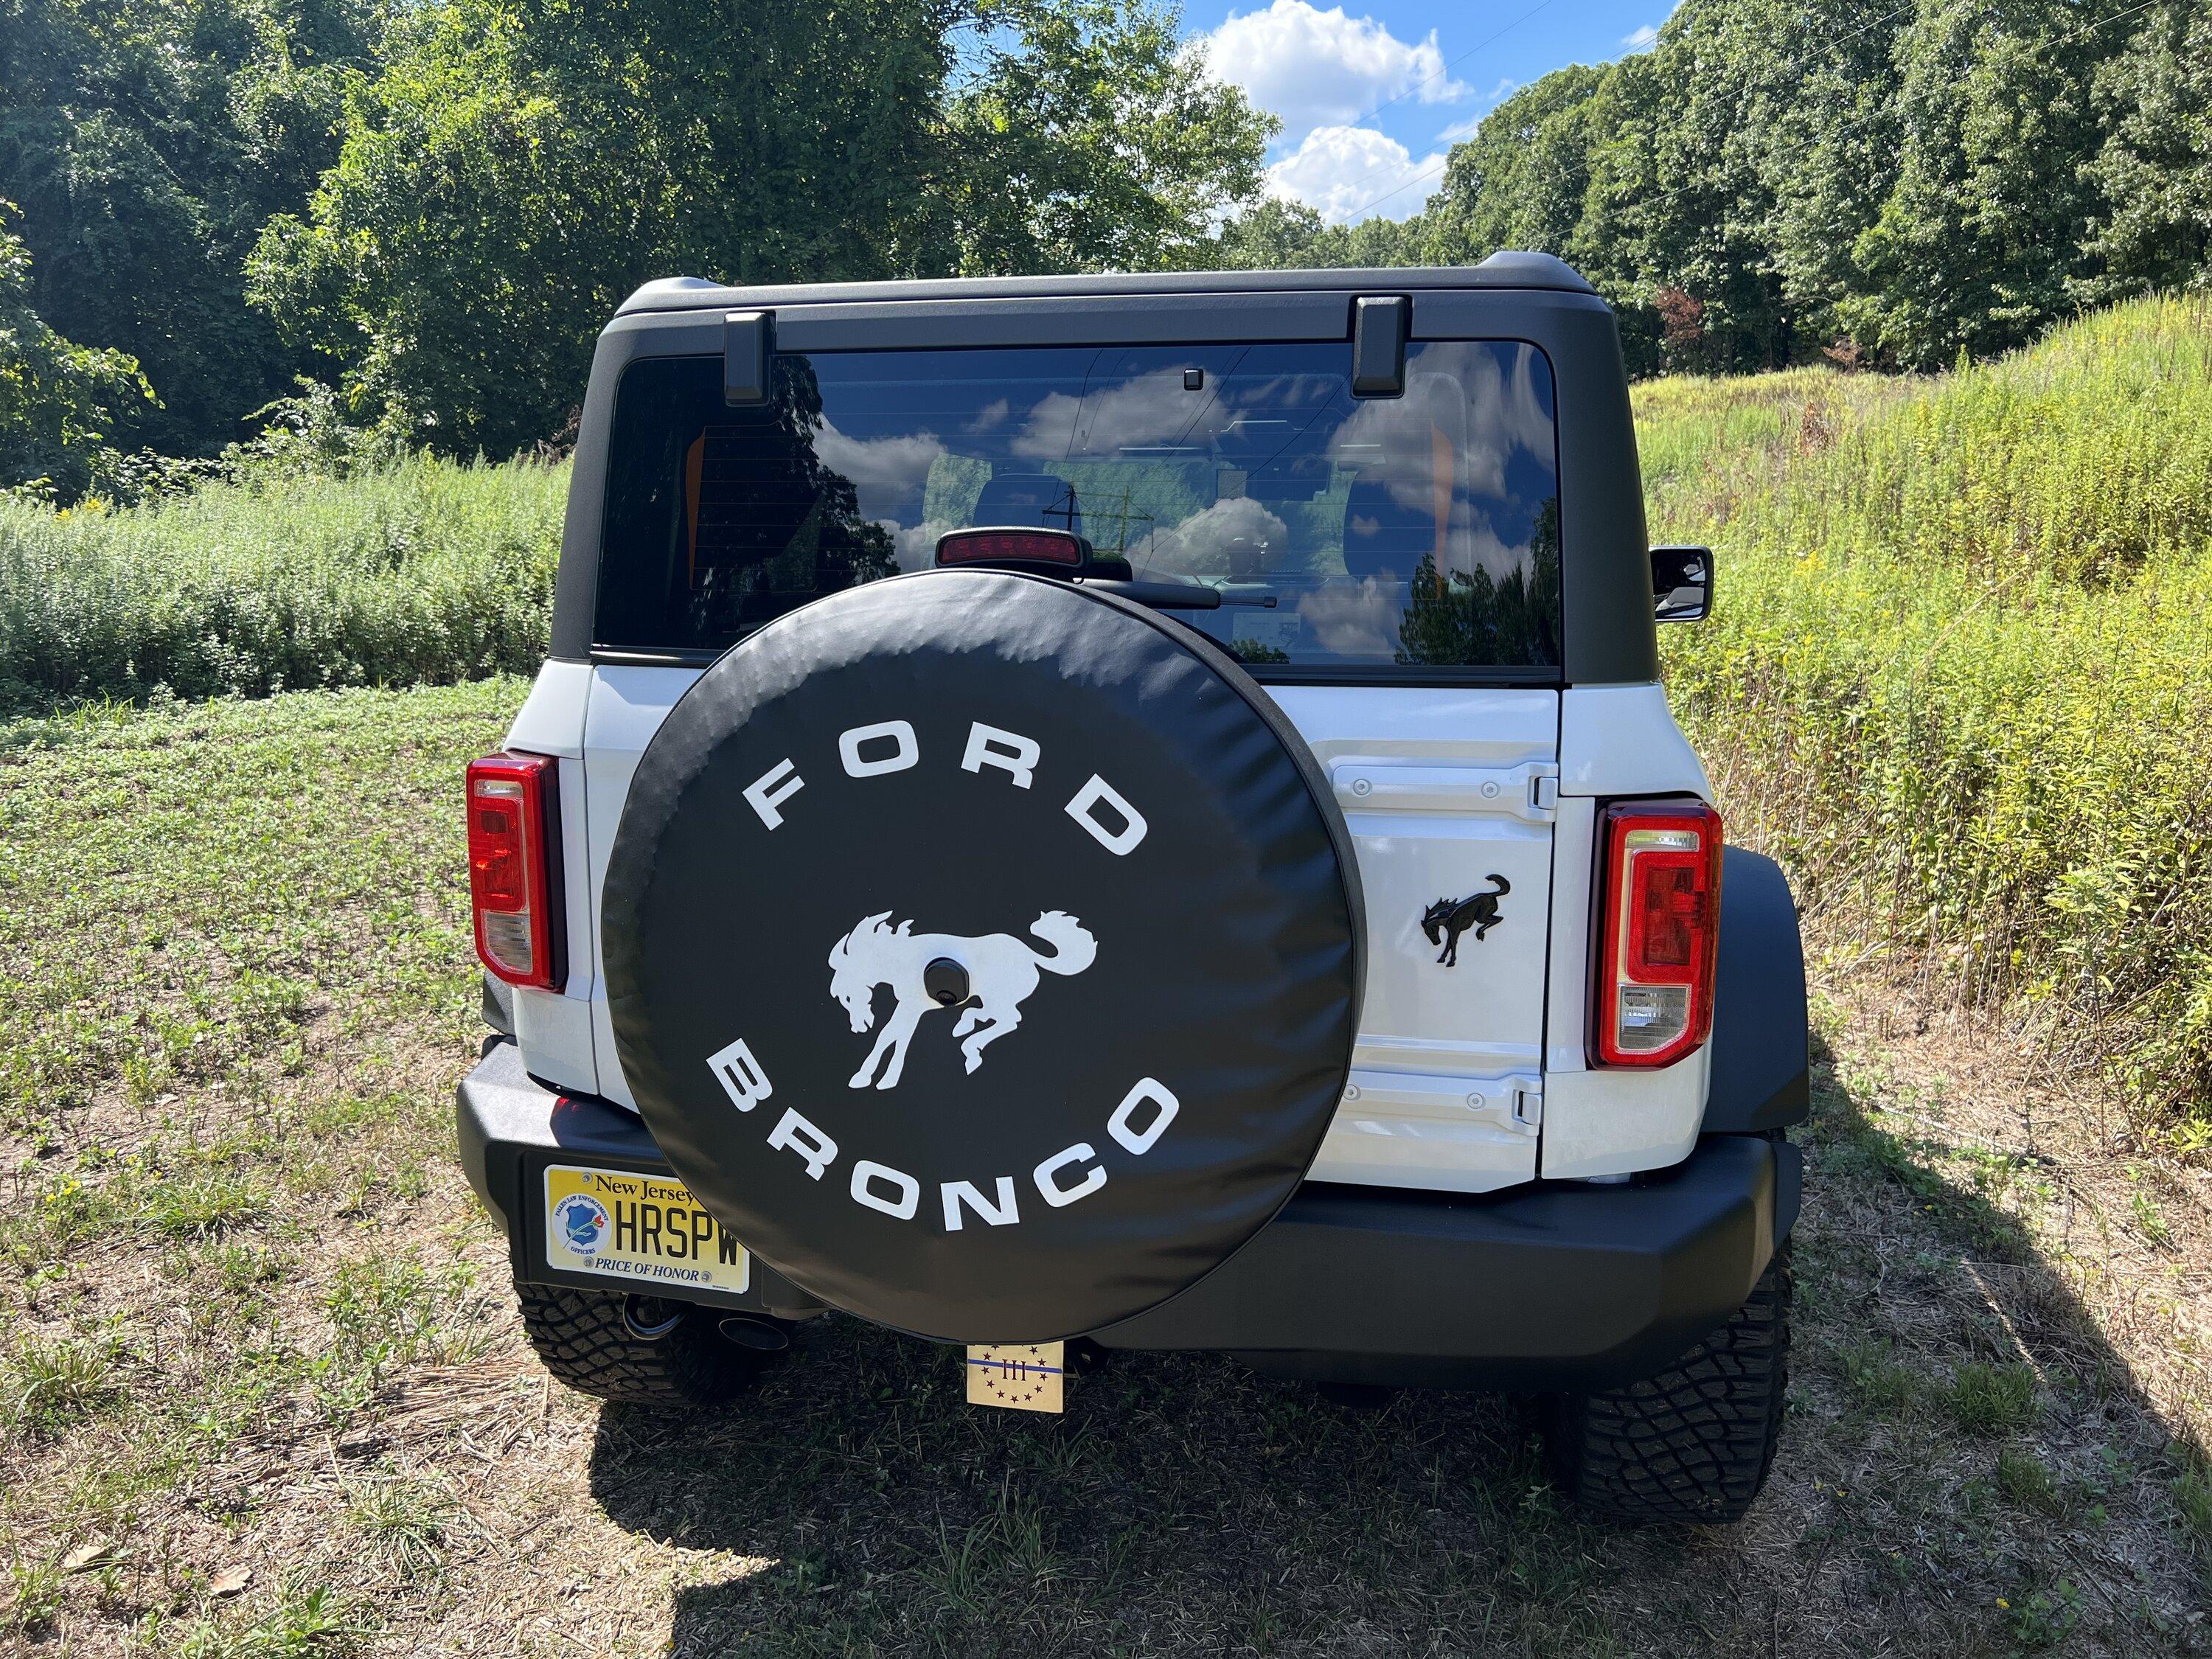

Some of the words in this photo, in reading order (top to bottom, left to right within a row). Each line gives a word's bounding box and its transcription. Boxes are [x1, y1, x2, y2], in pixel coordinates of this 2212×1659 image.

[742, 720, 1148, 856] FORD
[706, 1037, 1180, 1232] BRONCO
[595, 1175, 638, 1195] New
[640, 1180, 695, 1206] Jersey
[555, 1200, 568, 1217] FALLEN
[578, 1195, 609, 1221] ENFORCEMENT
[616, 1200, 737, 1266] HRSPW
[570, 1246, 596, 1254] OFFICERS
[595, 1258, 632, 1273] PRICE
[634, 1262, 652, 1275] OF
[653, 1265, 700, 1281] HONOR
